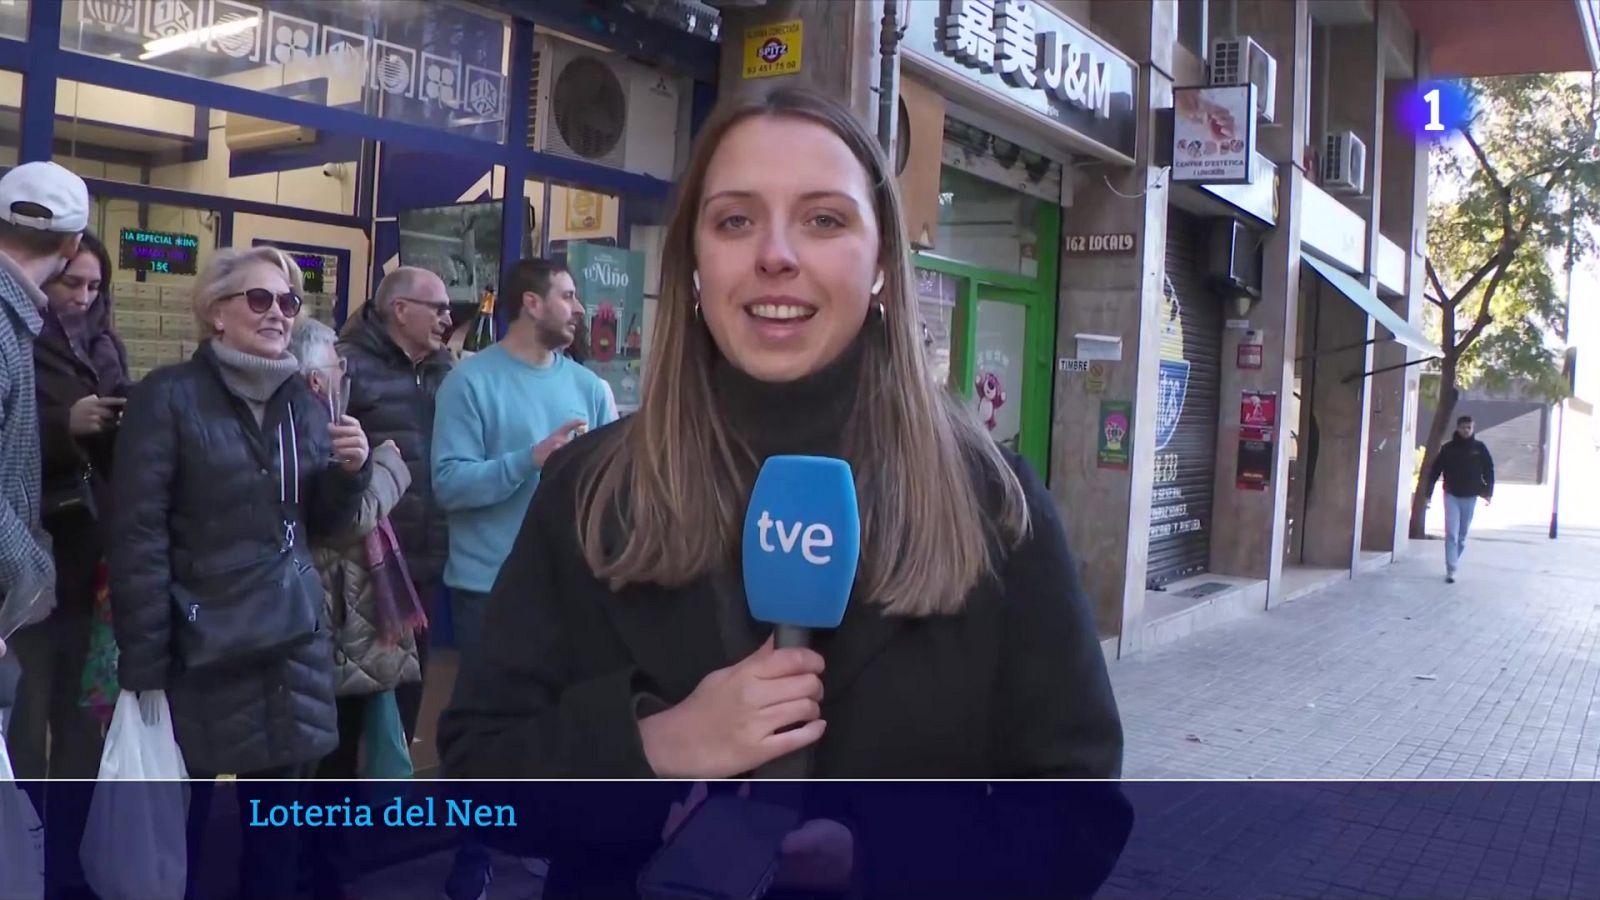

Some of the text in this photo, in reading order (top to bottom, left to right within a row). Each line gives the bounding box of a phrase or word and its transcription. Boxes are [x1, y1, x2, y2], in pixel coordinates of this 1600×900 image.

[758, 44, 788, 58] SPITZ
[1043, 30, 1111, 120] J&M
[136, 233, 173, 245] ESPECIAL
[1065, 234, 1087, 251] 162
[151, 260, 169, 273] 15€
[1060, 360, 1089, 371] TIMBRE
[757, 510, 833, 566] tve
